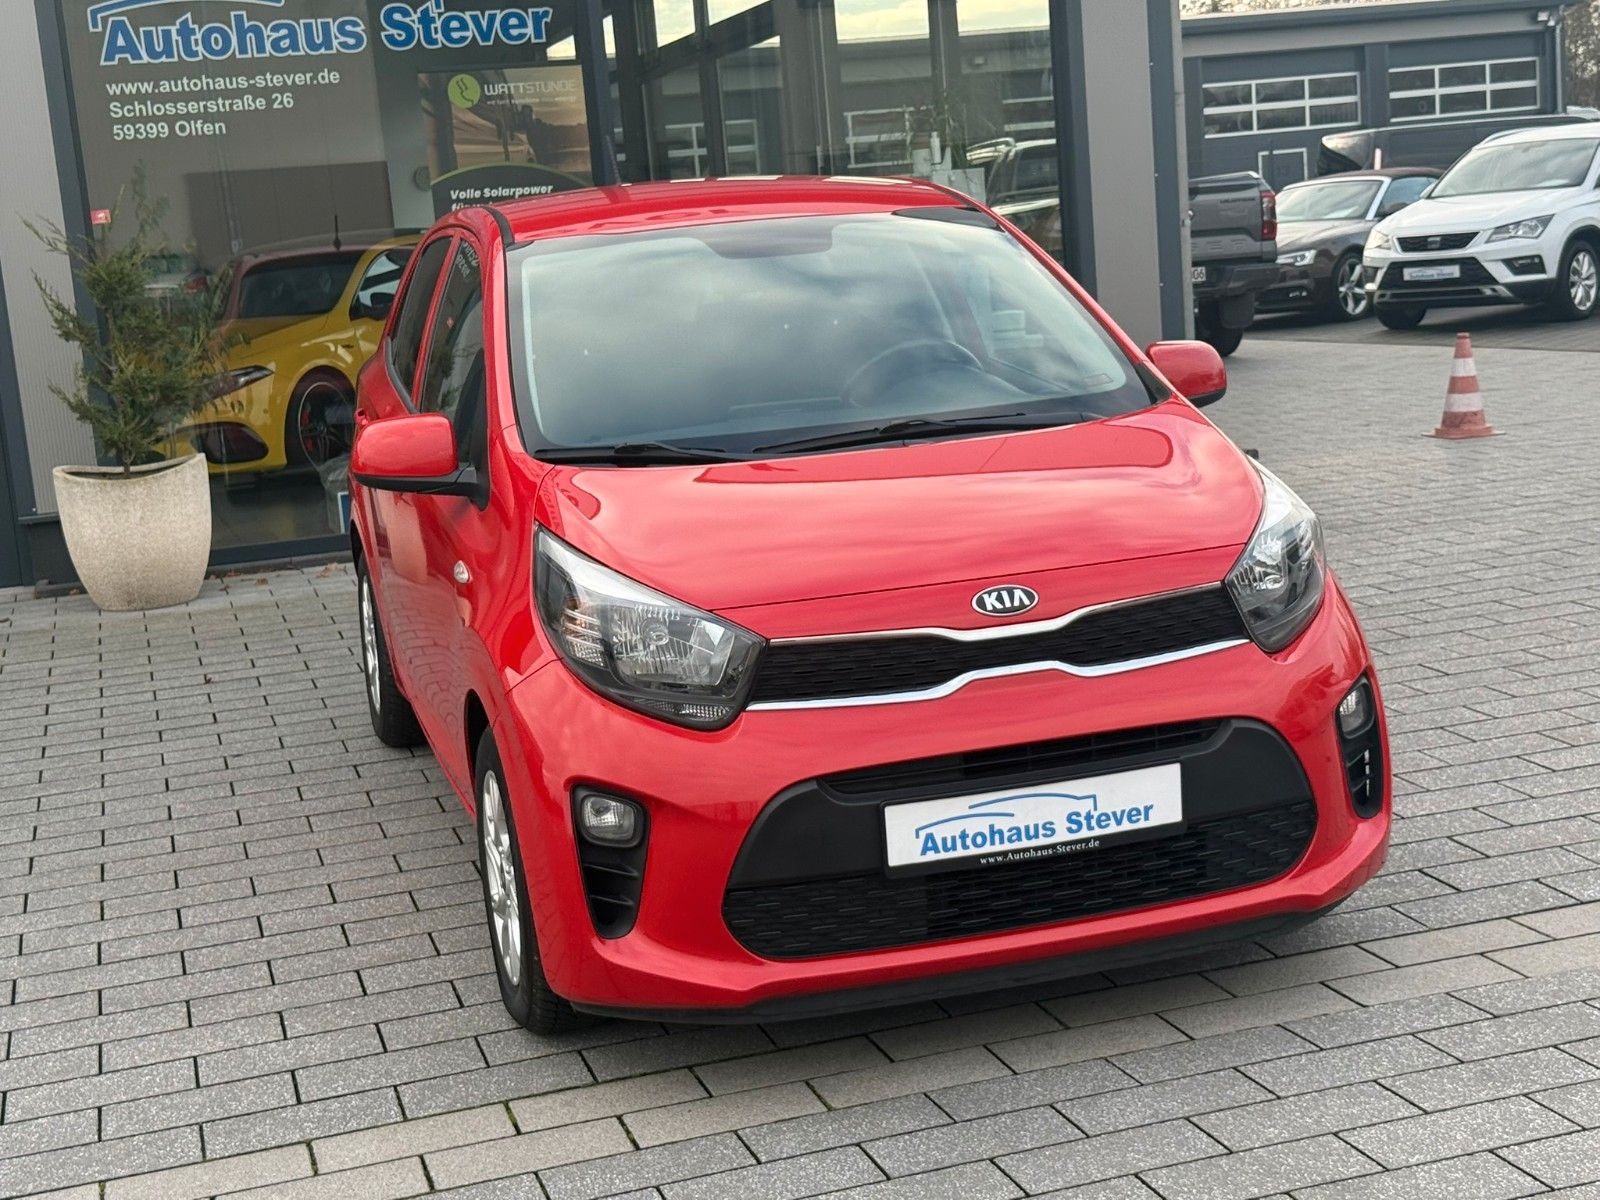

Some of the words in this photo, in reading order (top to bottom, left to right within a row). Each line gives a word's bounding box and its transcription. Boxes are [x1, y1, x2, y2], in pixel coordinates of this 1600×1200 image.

[100, 11, 367, 66] Autohaus
[380, 2, 553, 51] Stever
[106, 69, 340, 95] www.autohaus-stever.de
[484, 79, 577, 97] WATTSTUNDE
[109, 95, 266, 118] Schlosserstraße
[272, 93, 294, 109] 26
[113, 122, 169, 141] 59399
[175, 120, 226, 137] Olfen
[450, 189, 482, 200] Volle
[483, 184, 553, 199] Solarpower
[982, 589, 1031, 611] KIA
[920, 819, 1056, 856] Autohaus
[1066, 804, 1154, 834] Stever
[979, 839, 1100, 864] www.Autohaus-Stever.de
